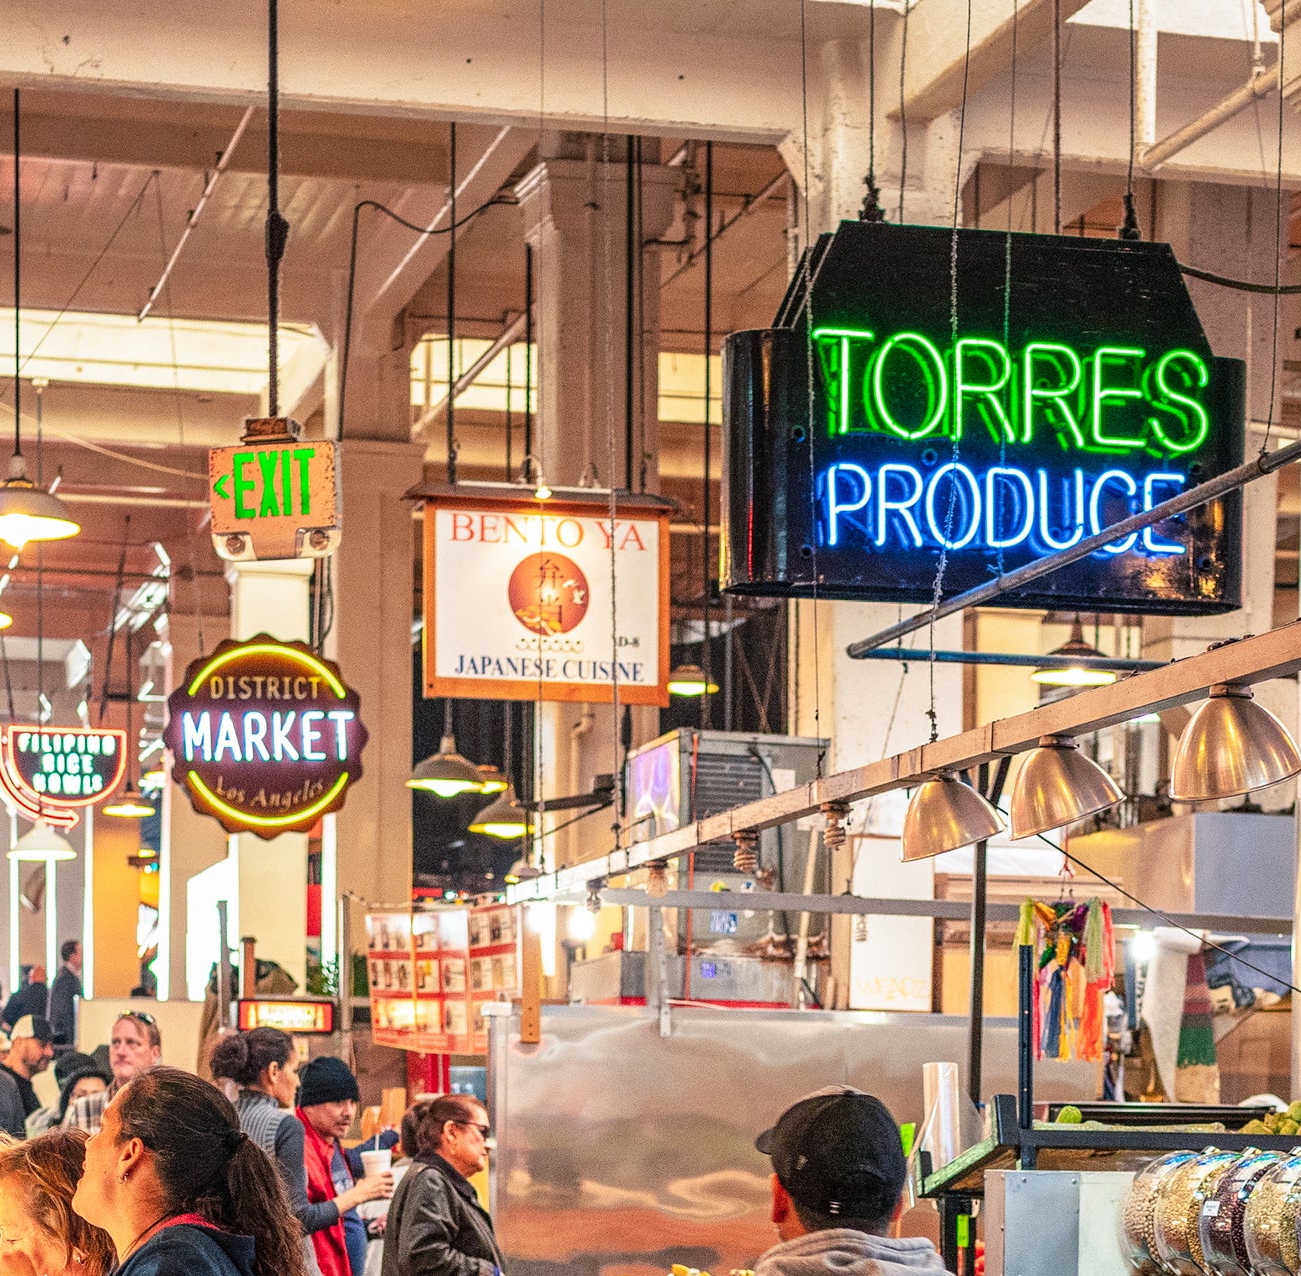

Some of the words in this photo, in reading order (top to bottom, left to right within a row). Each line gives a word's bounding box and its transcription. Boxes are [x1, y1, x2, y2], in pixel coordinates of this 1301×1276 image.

[812, 327, 1210, 453] TORRES
[232, 447, 316, 520] EXIT
[826, 461, 1187, 556] PRODUCE
[450, 512, 585, 548] BENTO
[595, 521, 648, 552] YA
[209, 674, 322, 702] DISTRICT
[454, 654, 558, 679] JAPANESE
[562, 659, 645, 683] CUISINE
[181, 710, 355, 763] MARKET
[215, 778, 247, 803] Los
[249, 779, 325, 808] Angeles
